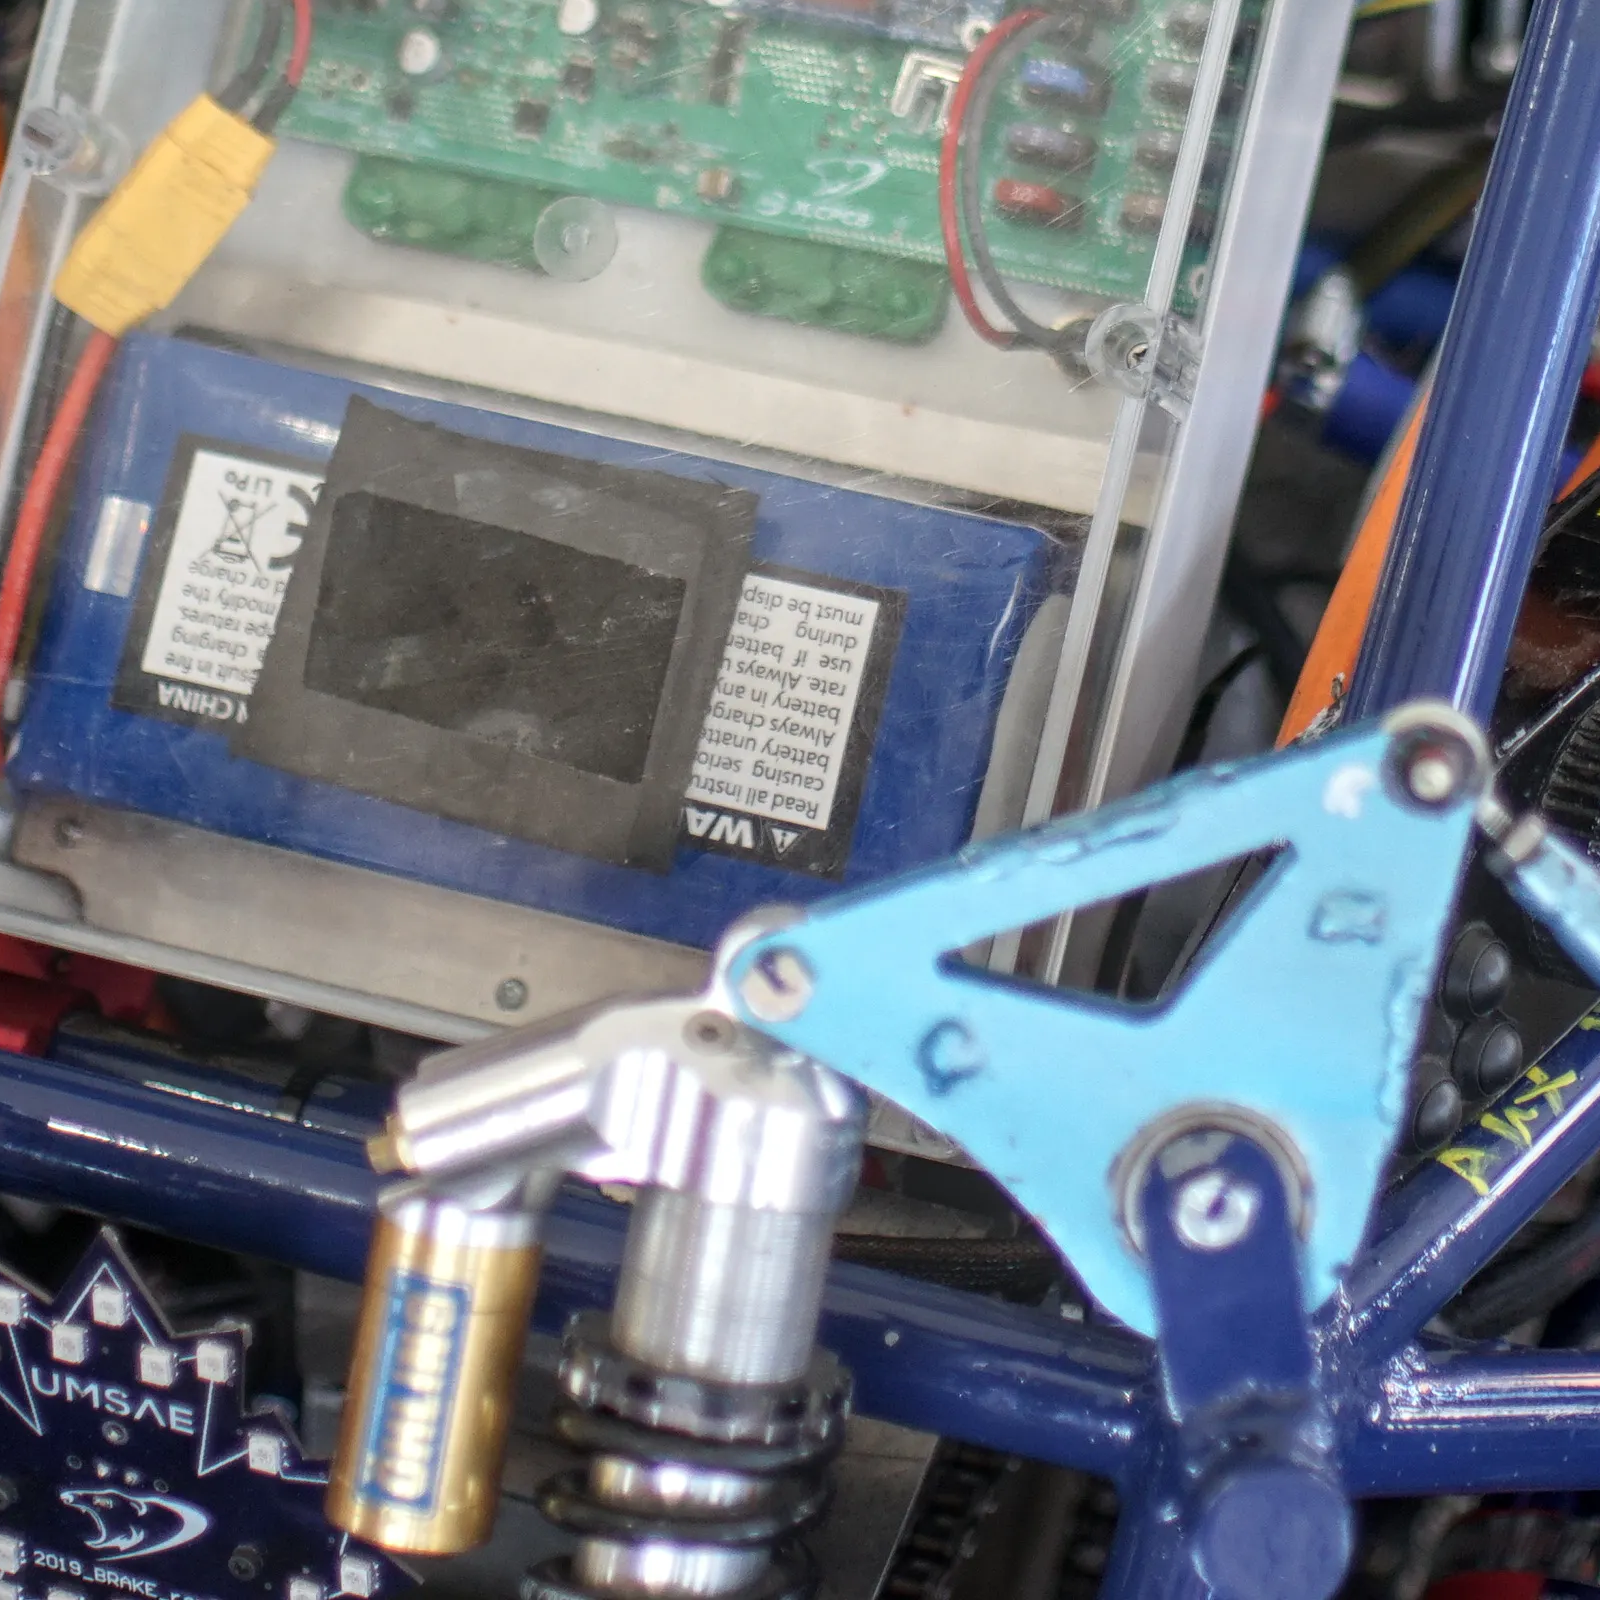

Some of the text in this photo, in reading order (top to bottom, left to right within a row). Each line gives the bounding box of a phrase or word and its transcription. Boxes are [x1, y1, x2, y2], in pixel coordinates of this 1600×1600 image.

[225, 471, 273, 496] Li Po
[189, 561, 248, 586] charge
[251, 576, 269, 589] or
[183, 584, 276, 615] modify the
[788, 599, 811, 620] be
[816, 605, 863, 625] must
[172, 626, 247, 660] charging
[796, 621, 857, 653] during
[165, 653, 192, 674] fire
[793, 650, 807, 667] if
[820, 655, 851, 672] use
[737, 660, 801, 690] Always
[805, 677, 846, 697] rate.
[159, 683, 234, 719] CHINA
[751, 689, 767, 707] in
[772, 691, 840, 724] battery
[770, 717, 835, 747] Always
[761, 739, 829, 773] battery
[752, 760, 824, 791] causing
[746, 788, 768, 806] all
[771, 794, 818, 819] Read
[31, 1366, 196, 1436] UMSAE
